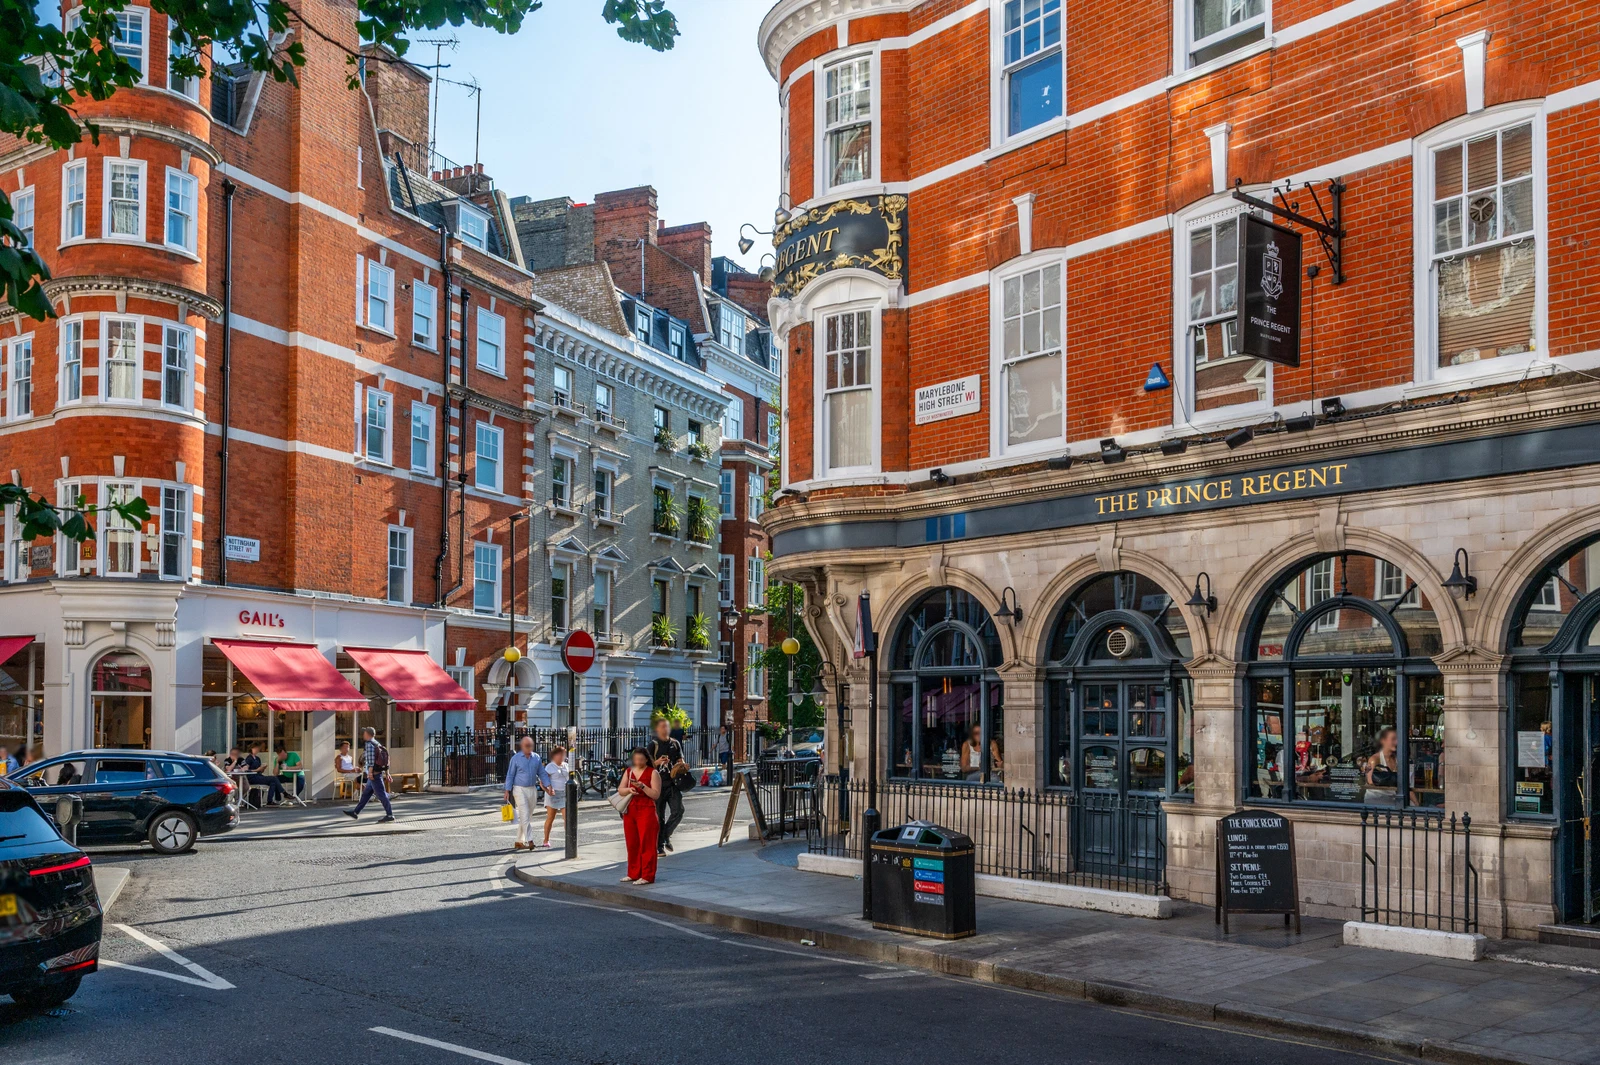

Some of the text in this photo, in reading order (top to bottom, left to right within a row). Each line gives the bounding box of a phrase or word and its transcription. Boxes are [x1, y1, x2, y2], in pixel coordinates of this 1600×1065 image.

[1266, 305, 1277, 315] THE
[1250, 316, 1291, 334] PRINCE REGENT
[919, 381, 966, 400] MARYLEBONE
[918, 391, 975, 412] HIGH STREET W1
[1094, 463, 1348, 515] THE PRINCE REGENT
[228, 538, 256, 547] NOTTINGHAM
[228, 544, 244, 552] STREET
[239, 610, 285, 628] GAIL's
[1228, 818, 1282, 828] THE PRINCE REGENT
[1230, 863, 1241, 871] SET
